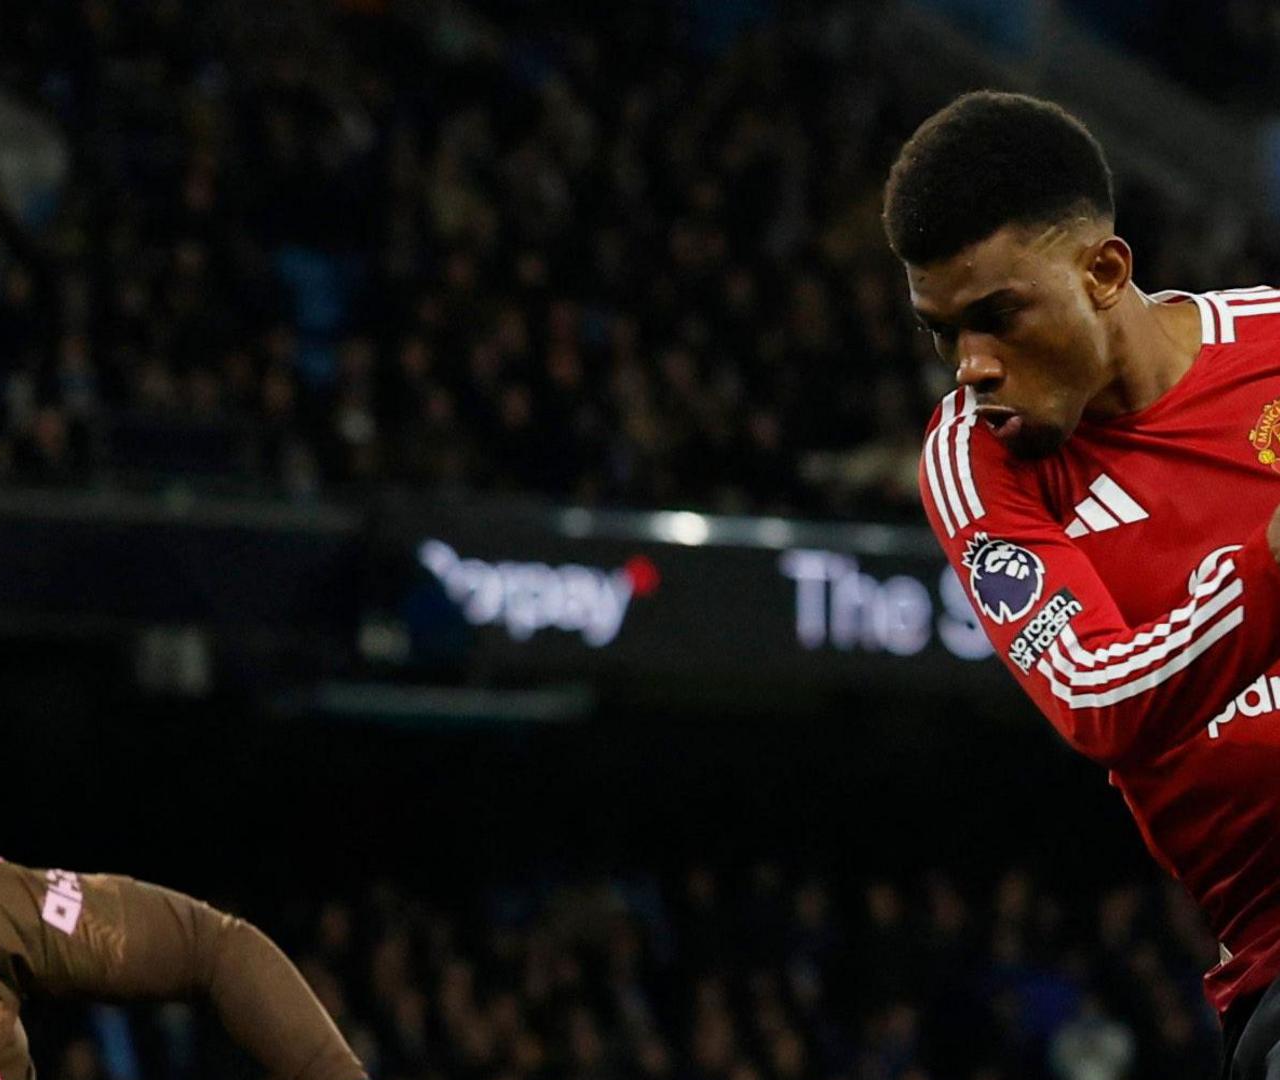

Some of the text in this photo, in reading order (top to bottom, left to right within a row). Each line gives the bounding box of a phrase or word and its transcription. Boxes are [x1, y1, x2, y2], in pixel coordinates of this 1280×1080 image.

[780, 549, 932, 656] The
[1023, 595, 1067, 643] room
[1031, 600, 1083, 654] racism
